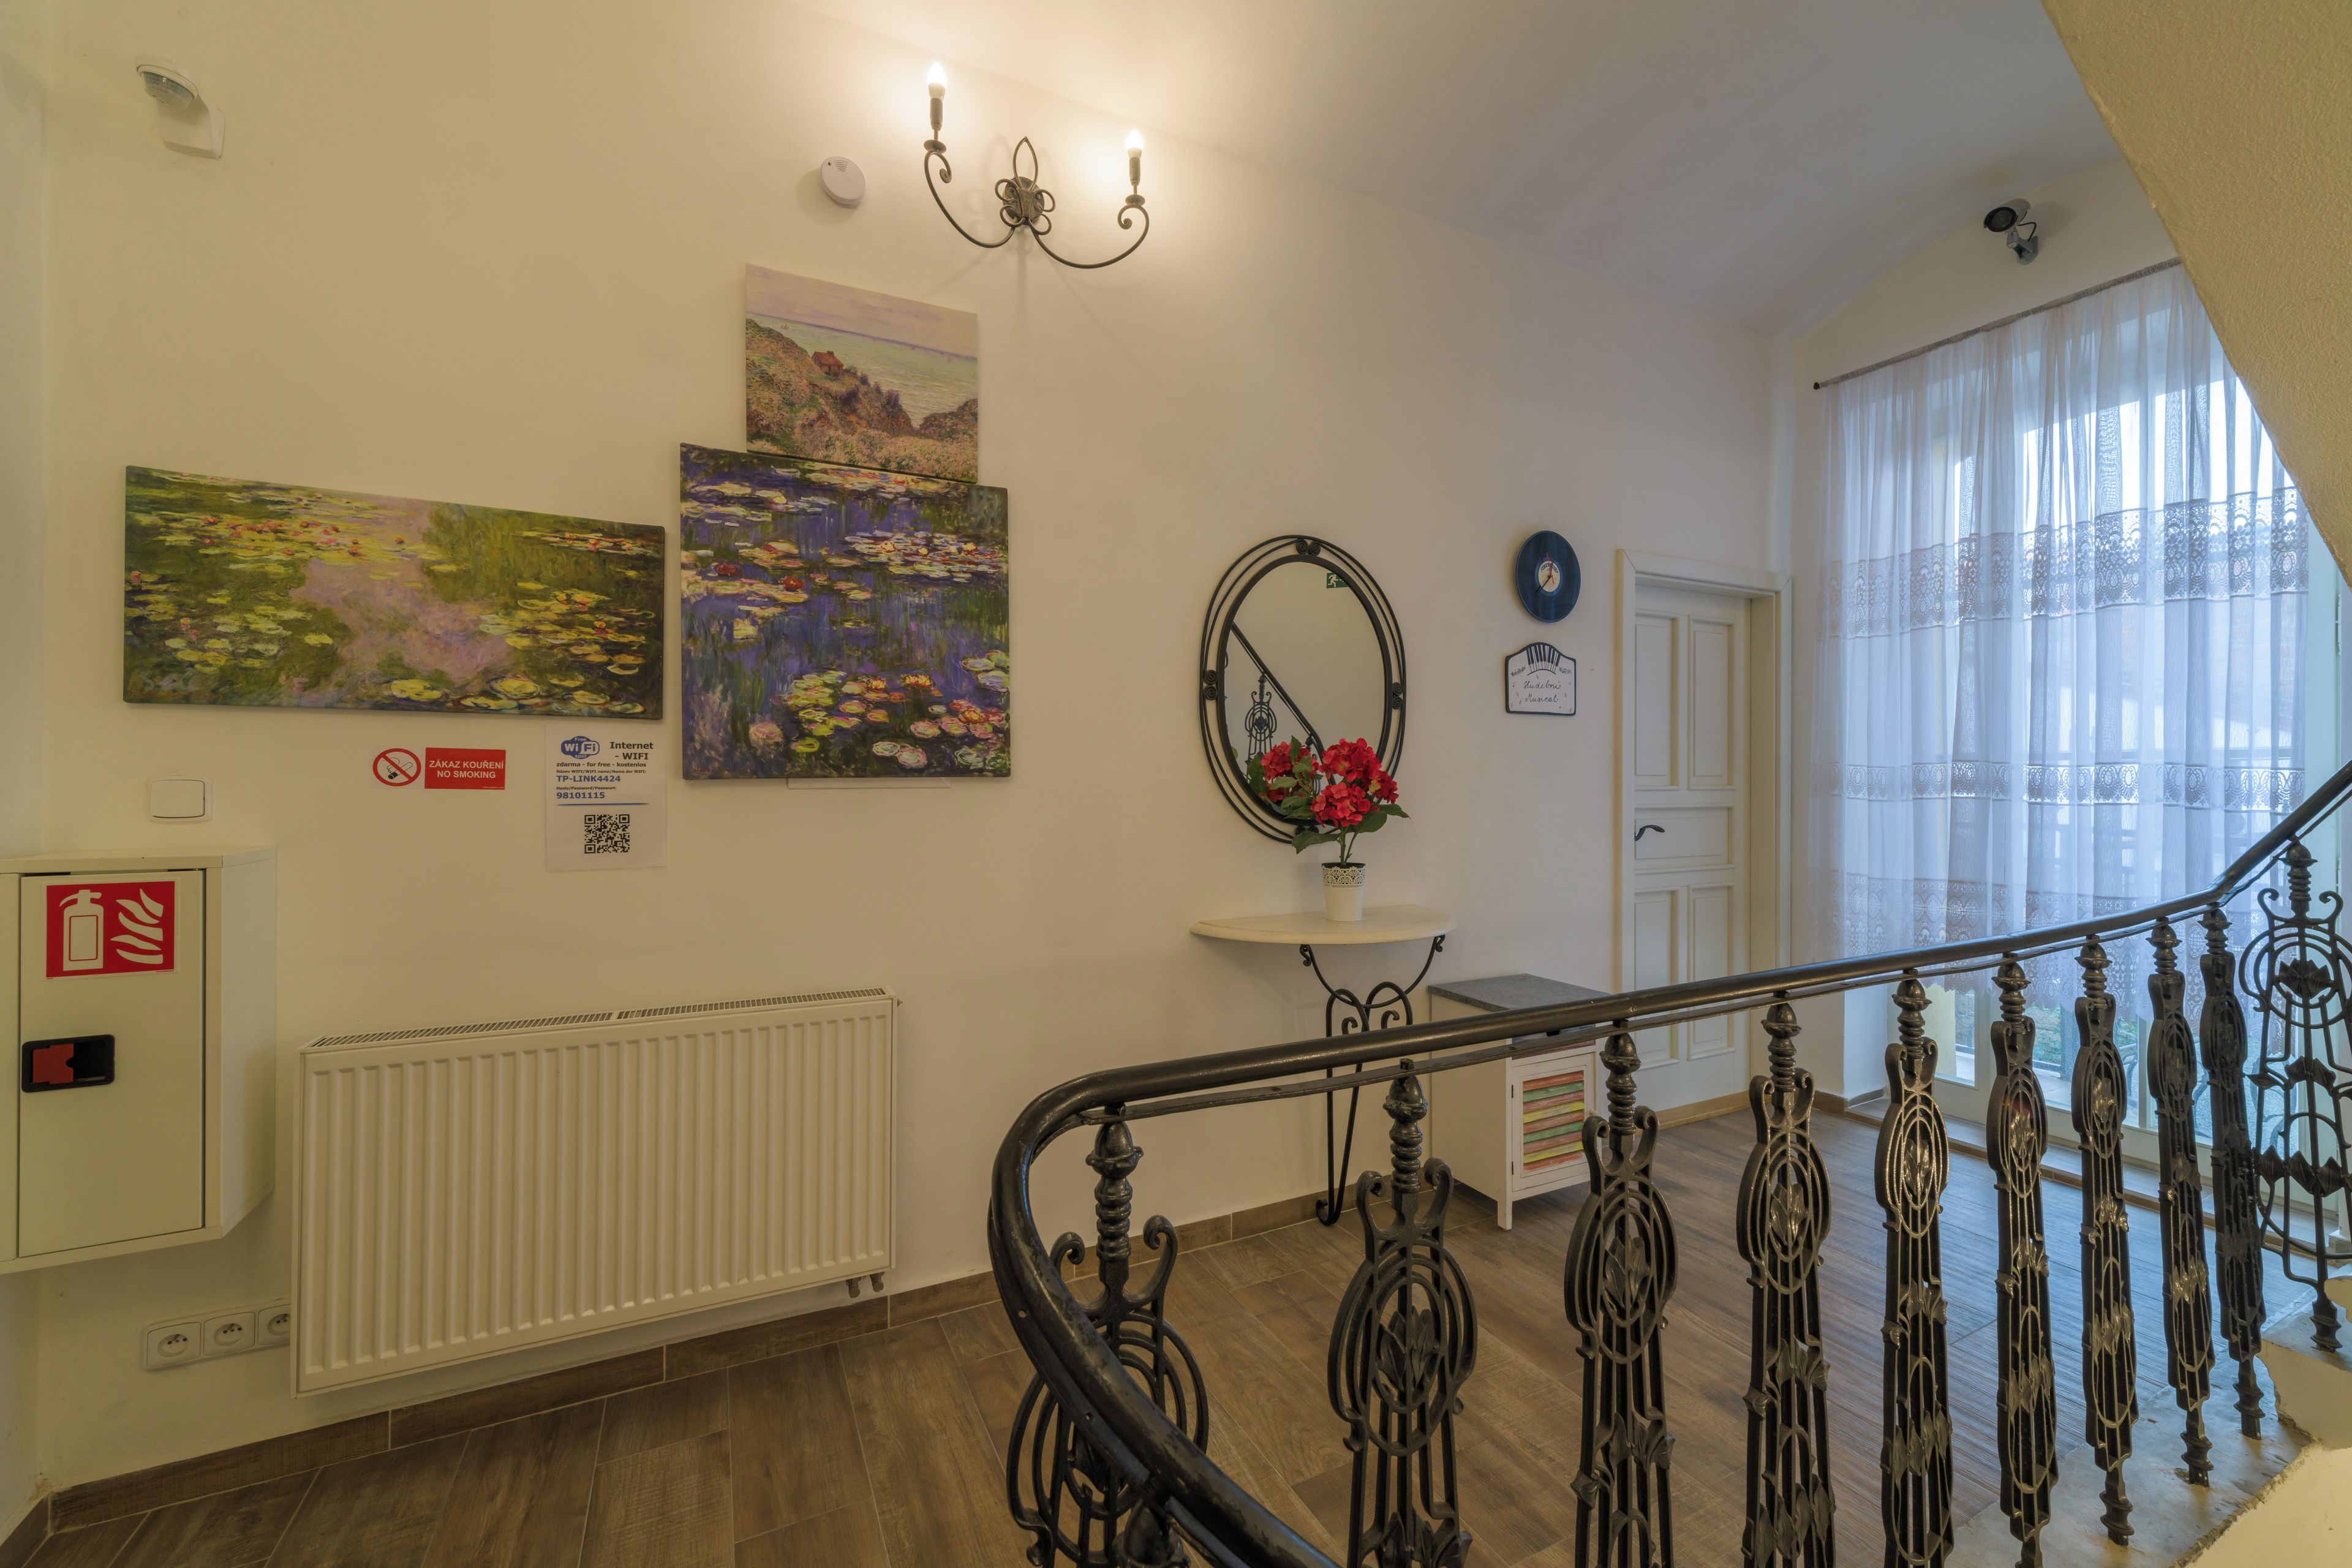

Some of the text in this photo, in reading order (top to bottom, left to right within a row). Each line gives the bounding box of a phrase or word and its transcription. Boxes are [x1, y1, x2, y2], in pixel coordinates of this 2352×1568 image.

[1525, 692, 1559, 703] Musical
[610, 741, 654, 750] Internet
[429, 760, 504, 769] ZÁKAZ KOUŘENÍ
